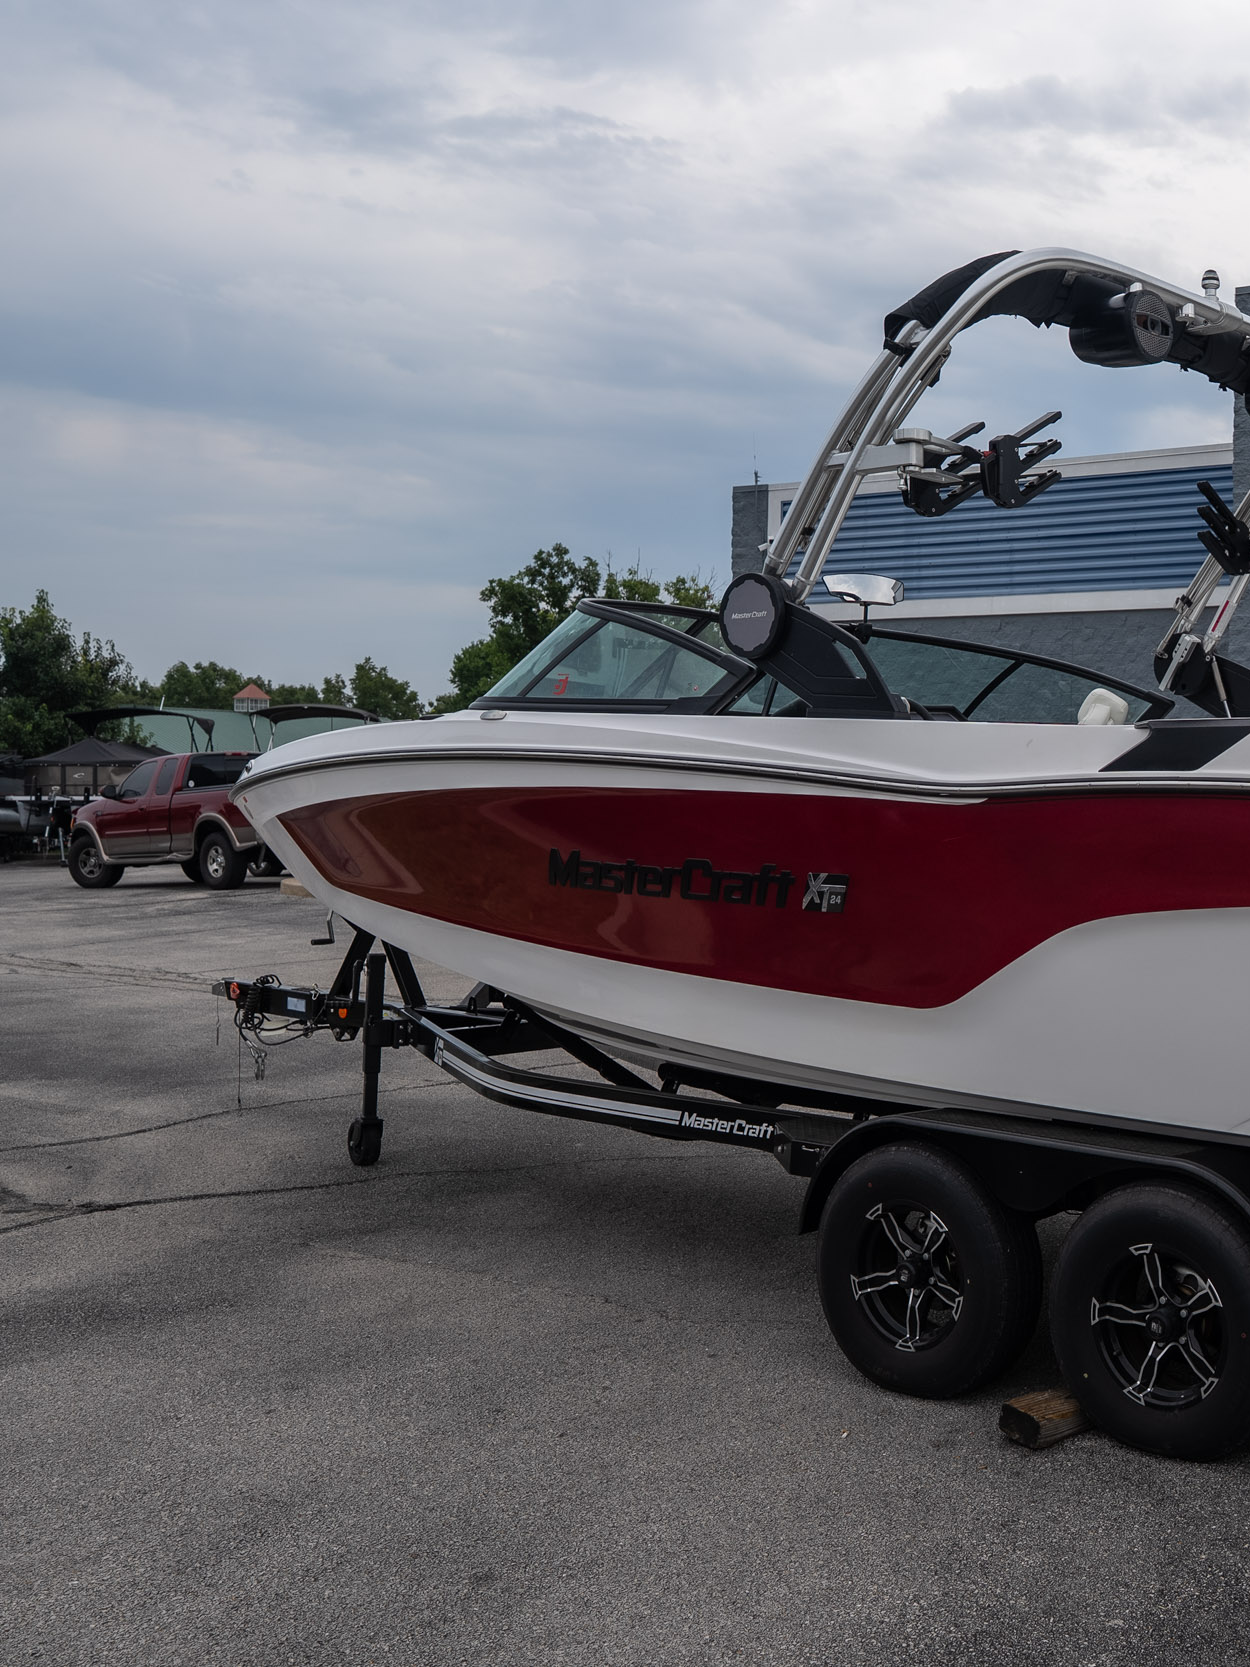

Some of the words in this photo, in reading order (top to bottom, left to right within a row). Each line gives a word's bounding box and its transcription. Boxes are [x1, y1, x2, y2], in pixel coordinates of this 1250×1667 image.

[731, 611, 767, 619] MasterCraft
[549, 847, 796, 908] MasterCraft
[681, 1111, 774, 1139] MasterCraft
